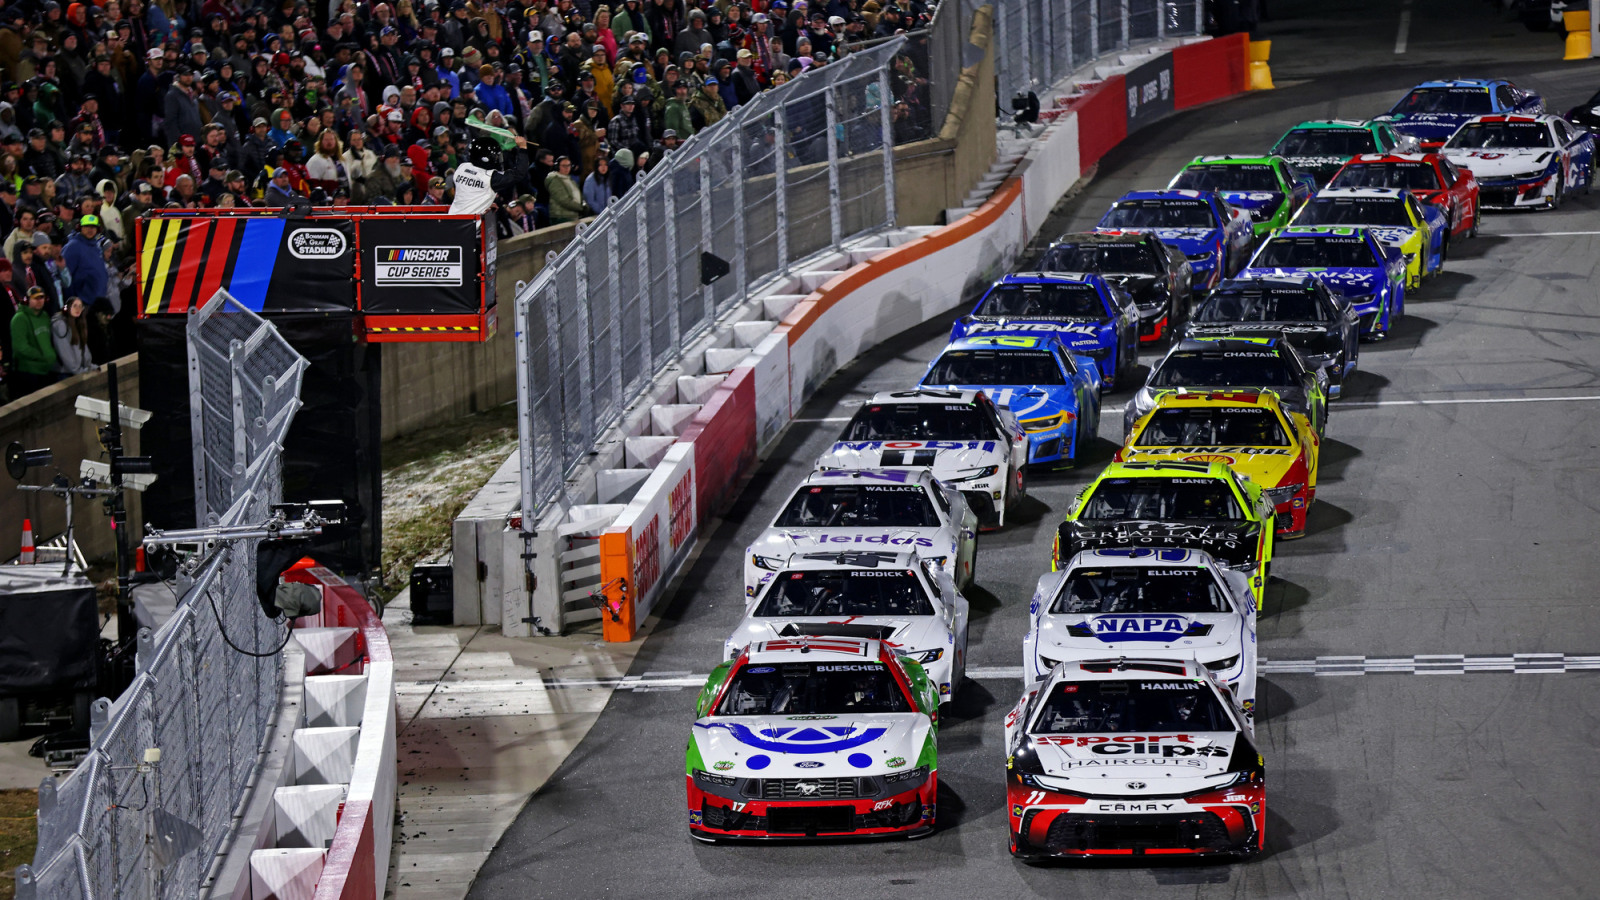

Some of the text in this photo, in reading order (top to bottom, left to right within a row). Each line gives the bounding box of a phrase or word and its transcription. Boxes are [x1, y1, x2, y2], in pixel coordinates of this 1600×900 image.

[455, 175, 485, 189] OFFICIAL
[299, 246, 337, 254] STADIUM
[402, 249, 450, 261] NASCAR
[387, 266, 451, 278] CUP SERIES
[1077, 529, 1239, 540] GREAT LAKES
[819, 534, 934, 547] leidos
[1079, 537, 1238, 549] FLOORING
[1096, 618, 1184, 632] NAPA
[1140, 682, 1200, 691] HAMLIN
[1067, 758, 1202, 769] HAIRCUTS
[1025, 791, 1047, 805] 11
[1222, 794, 1247, 802] JGR
[731, 801, 748, 812] 17
[1098, 803, 1175, 812] CAMRY
